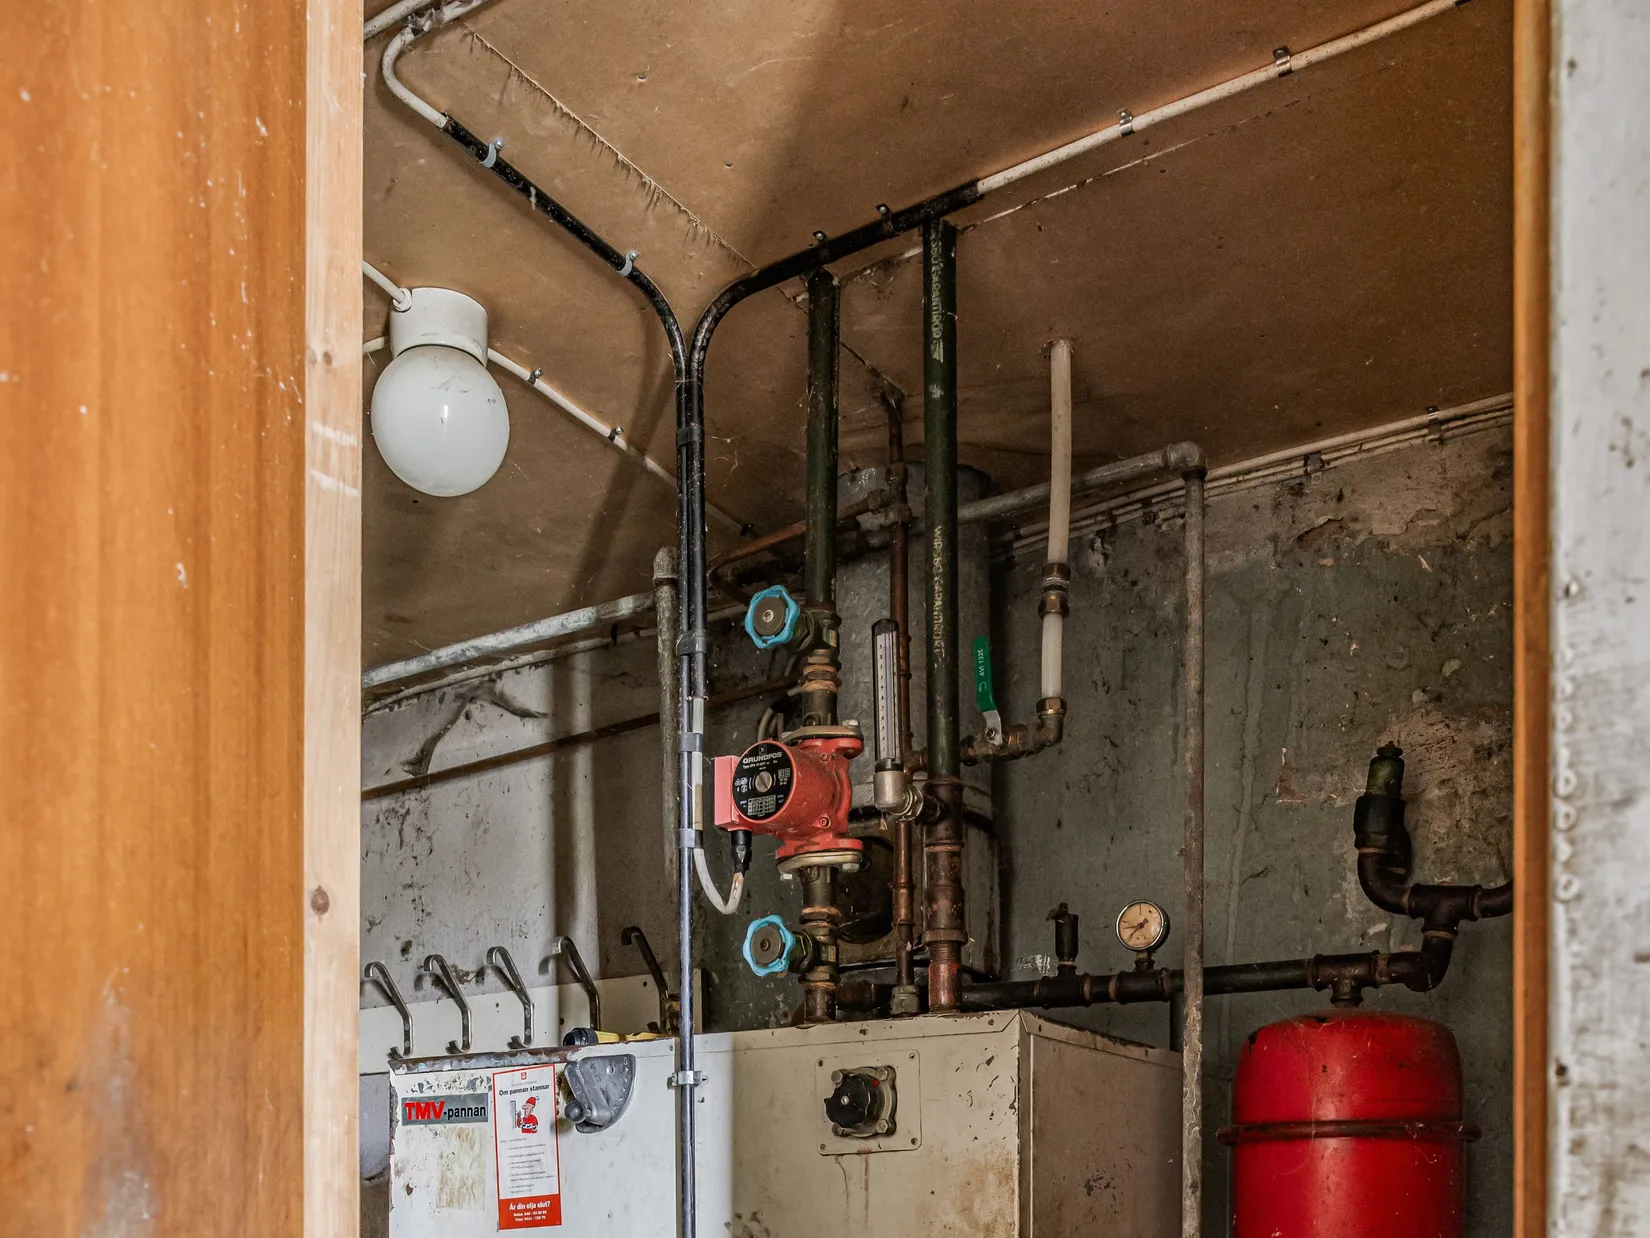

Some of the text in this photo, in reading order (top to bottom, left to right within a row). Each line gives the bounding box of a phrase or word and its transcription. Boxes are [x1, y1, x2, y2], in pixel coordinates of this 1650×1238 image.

[742, 752, 782, 764] GRUNDFOS
[509, 1087, 528, 1095] pannan
[404, 1100, 486, 1120] TMV-pannan
[526, 1202, 537, 1210] olja
[537, 1200, 551, 1208] slut?
